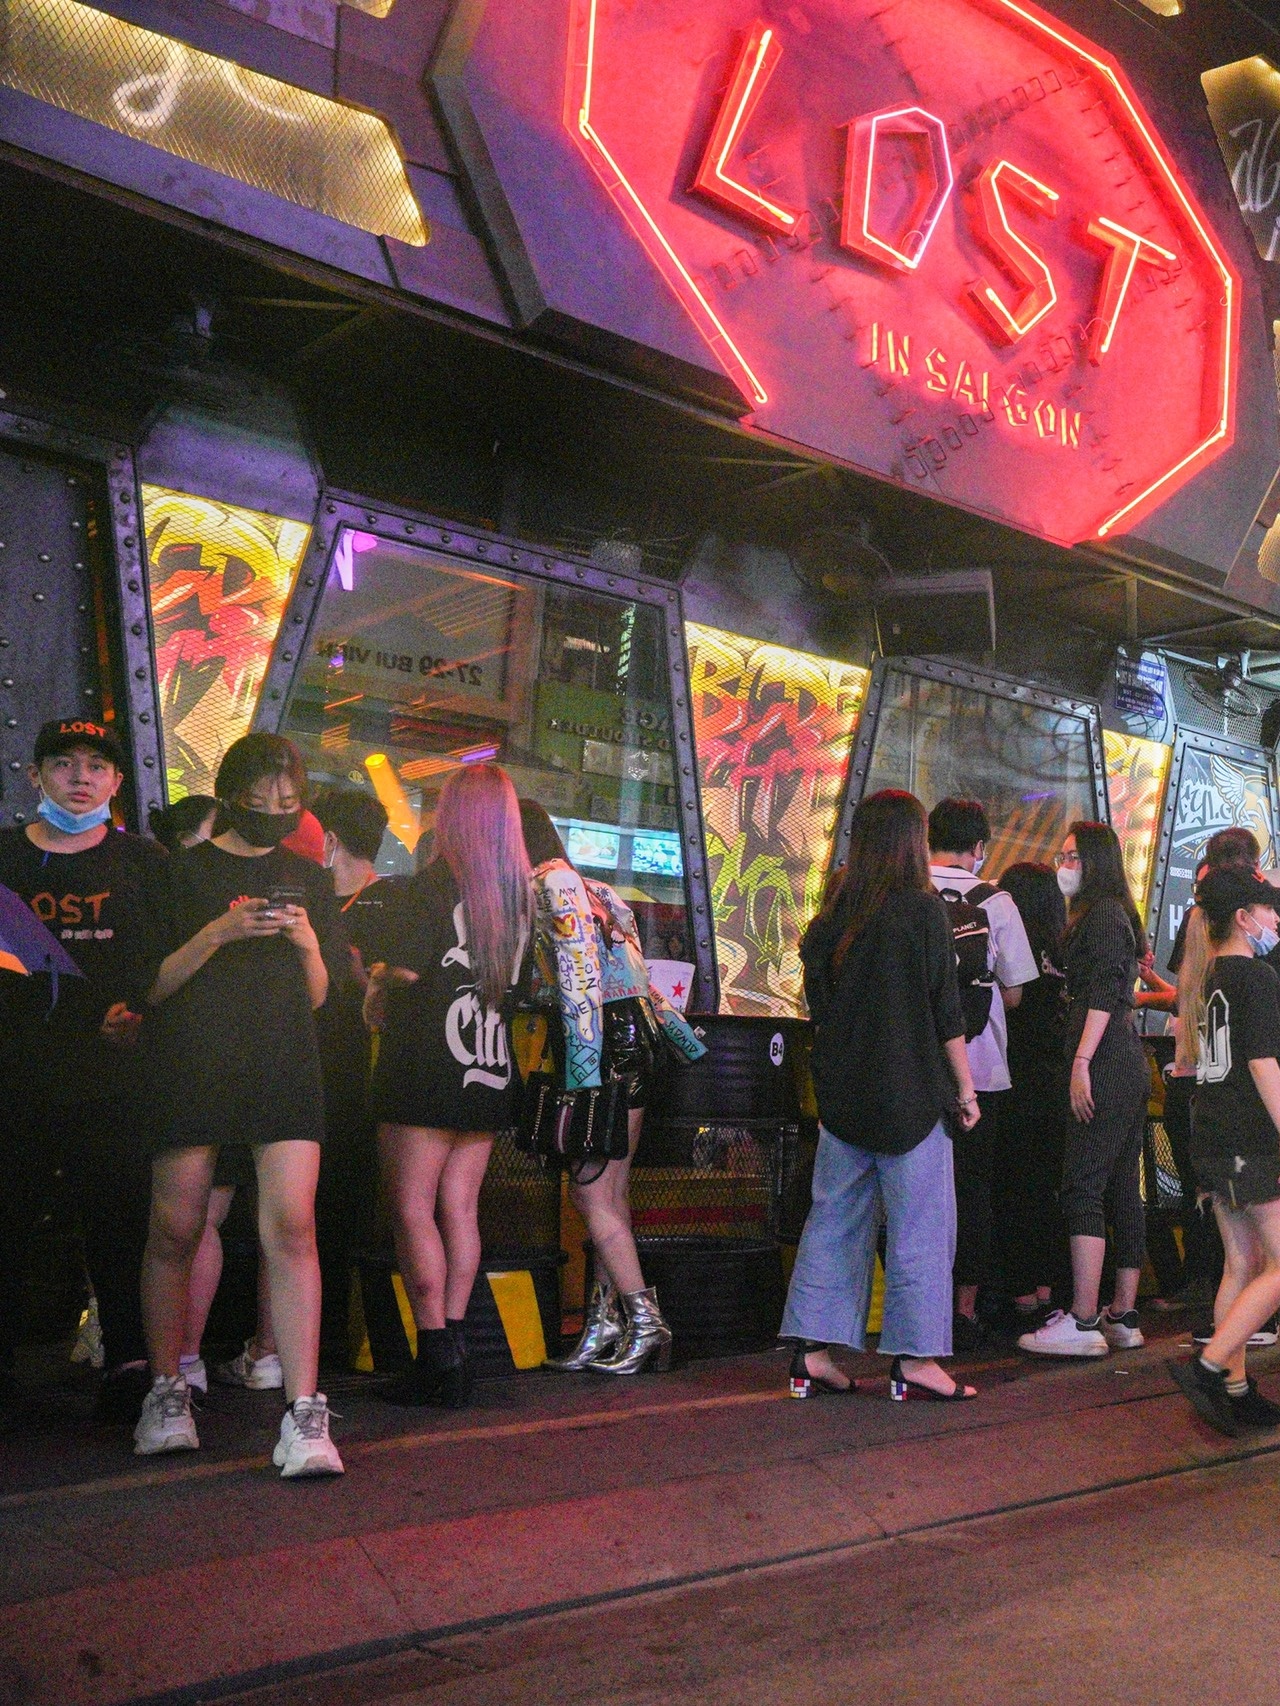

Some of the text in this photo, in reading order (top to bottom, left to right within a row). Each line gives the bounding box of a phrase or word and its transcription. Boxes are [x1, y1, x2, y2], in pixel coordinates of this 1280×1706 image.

[694, 19, 1178, 365] LOST
[866, 321, 1083, 450] IN SAIGON
[60, 721, 107, 738] LOST
[30, 891, 110, 924] OST
[445, 992, 511, 1089] City
